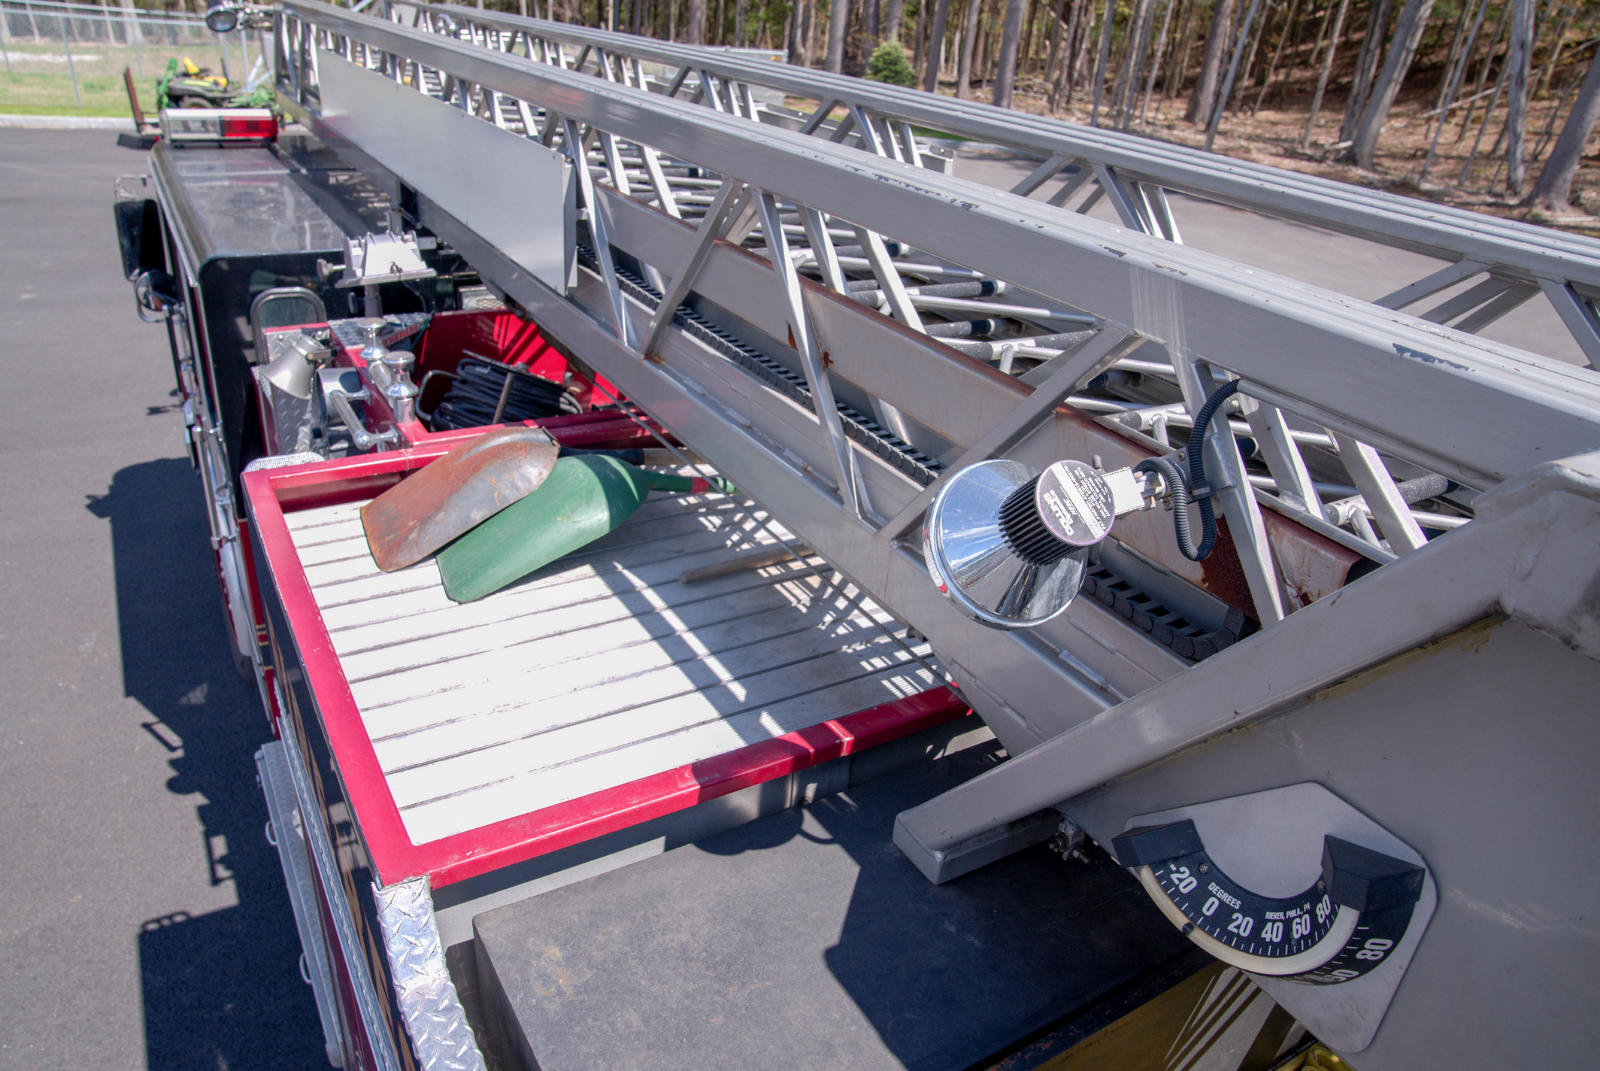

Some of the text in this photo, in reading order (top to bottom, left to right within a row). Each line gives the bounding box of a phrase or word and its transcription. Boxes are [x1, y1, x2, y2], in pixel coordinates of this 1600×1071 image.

[1170, 864, 1198, 894] -20
[1202, 897, 1219, 916] 0
[1207, 882, 1242, 910] DEGREES
[1316, 894, 1331, 924] 80
[1227, 913, 1254, 937] 20
[1260, 922, 1284, 943] 40
[1292, 914, 1311, 939] 60
[1356, 938, 1393, 960] 80
